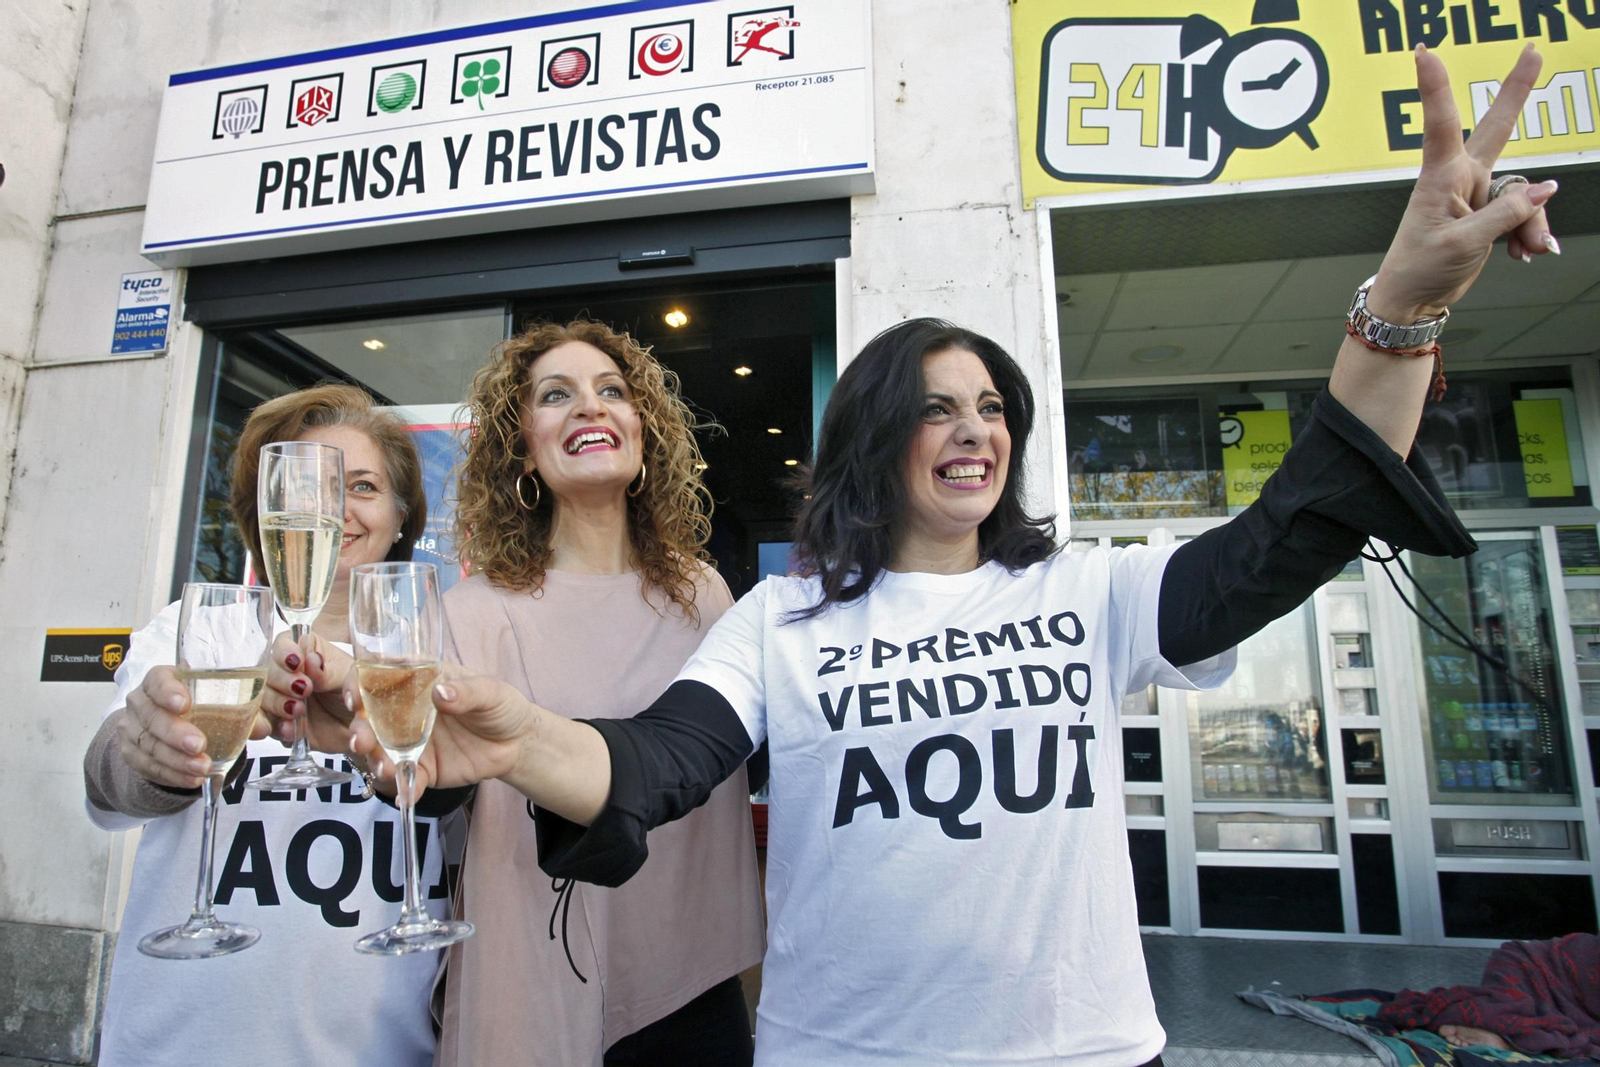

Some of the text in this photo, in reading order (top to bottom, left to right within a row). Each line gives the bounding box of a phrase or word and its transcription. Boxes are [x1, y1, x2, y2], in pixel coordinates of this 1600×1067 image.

[755, 75, 835, 91] Receptor 21.085
[255, 102, 722, 215] PRENSA Y REVISTAS
[123, 277, 163, 293] tyco
[117, 312, 155, 323] Alarma
[871, 611, 1086, 669] PREMIO
[50, 654, 63, 663] UPS
[64, 654, 83, 663] Access
[817, 662, 1092, 732] VENDIDO
[832, 711, 1096, 840] AQUÍ
[1486, 826, 1531, 840] PUSH
